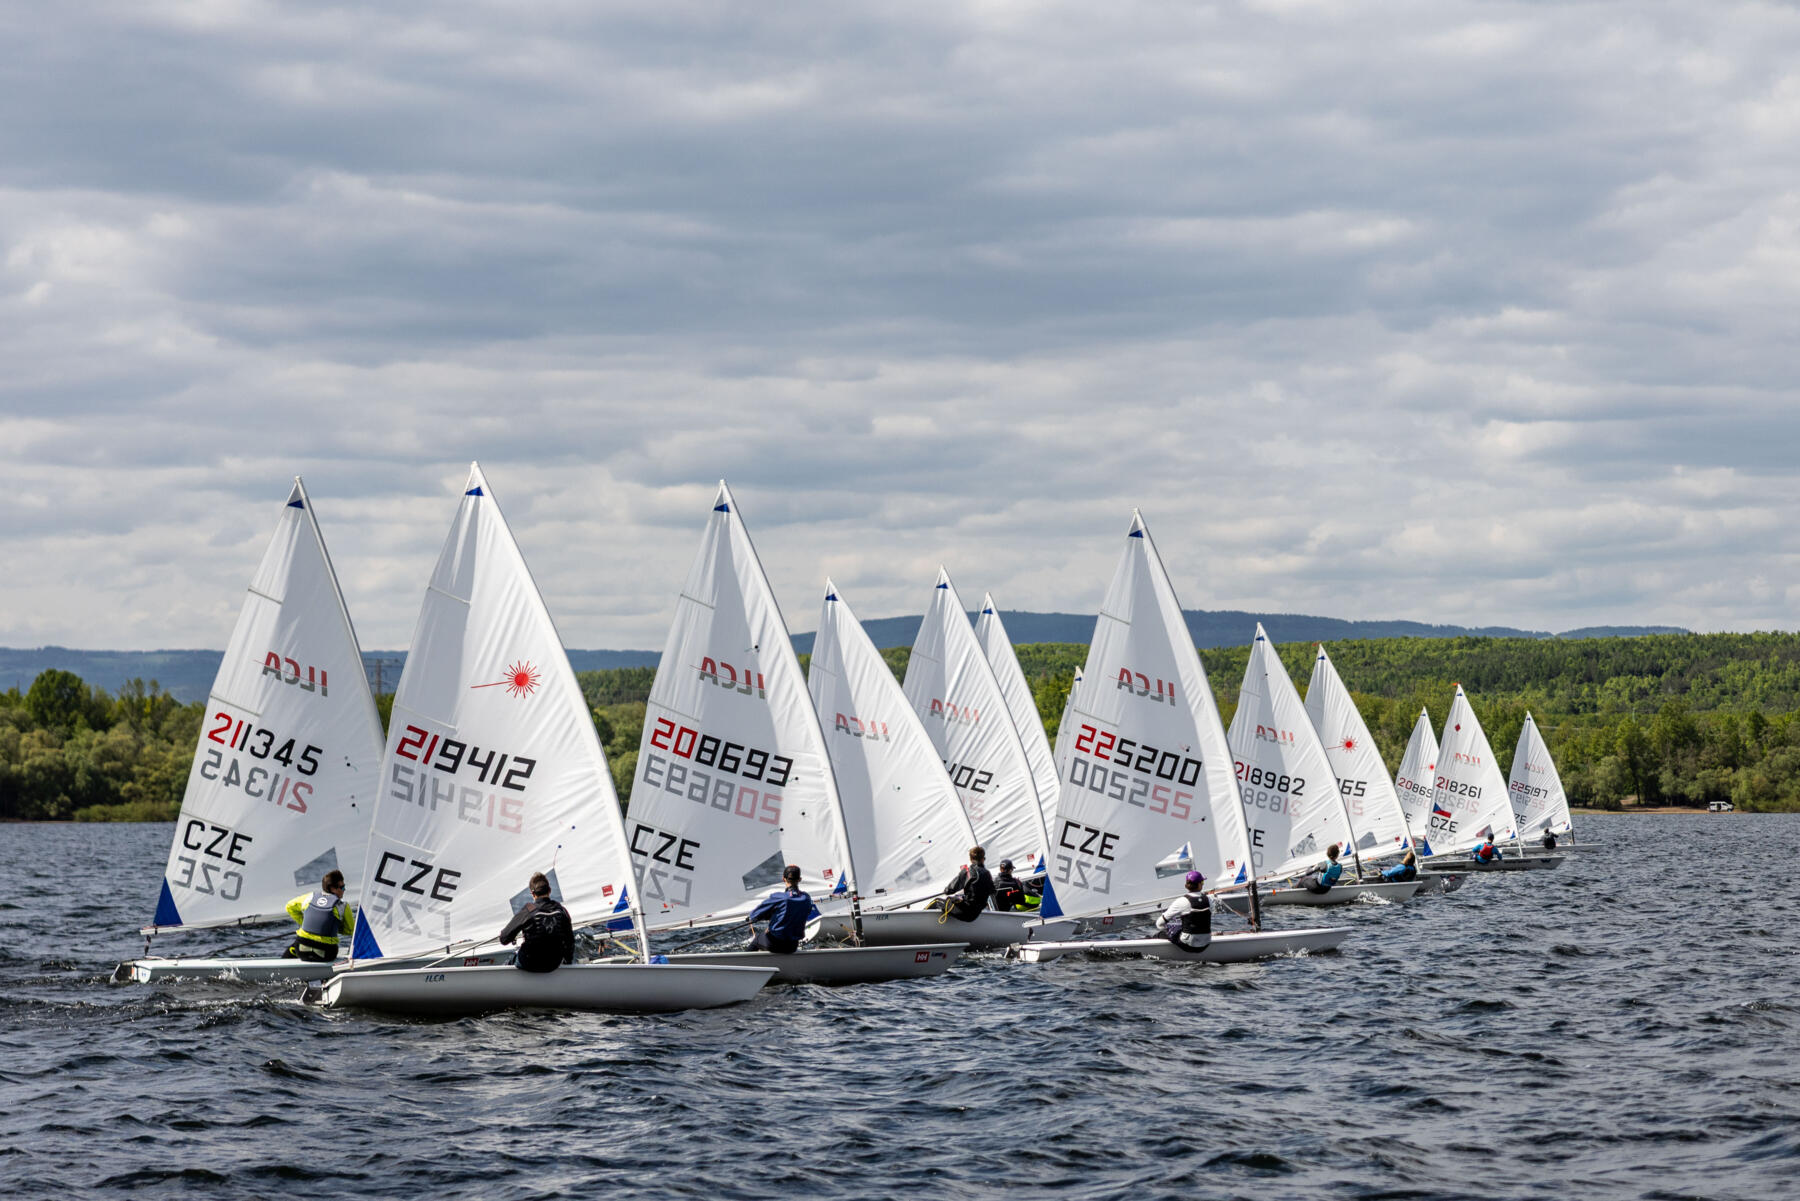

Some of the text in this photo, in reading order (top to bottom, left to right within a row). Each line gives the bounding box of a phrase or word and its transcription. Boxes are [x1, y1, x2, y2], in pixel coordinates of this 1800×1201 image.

[207, 712, 323, 776] 211345
[395, 724, 537, 792] 219412
[650, 717, 793, 787] 208693
[1075, 724, 1202, 787] 225200
[1234, 761, 1306, 796] 218982
[1436, 776, 1482, 799] 218261
[1510, 780, 1549, 799] 225197
[183, 820, 253, 866] CZE
[630, 824, 700, 871] CZE
[1060, 821, 1120, 861] CZE
[1430, 816, 1459, 833] CZE
[375, 851, 462, 903] CZE
[425, 974, 445, 982] ILCA
